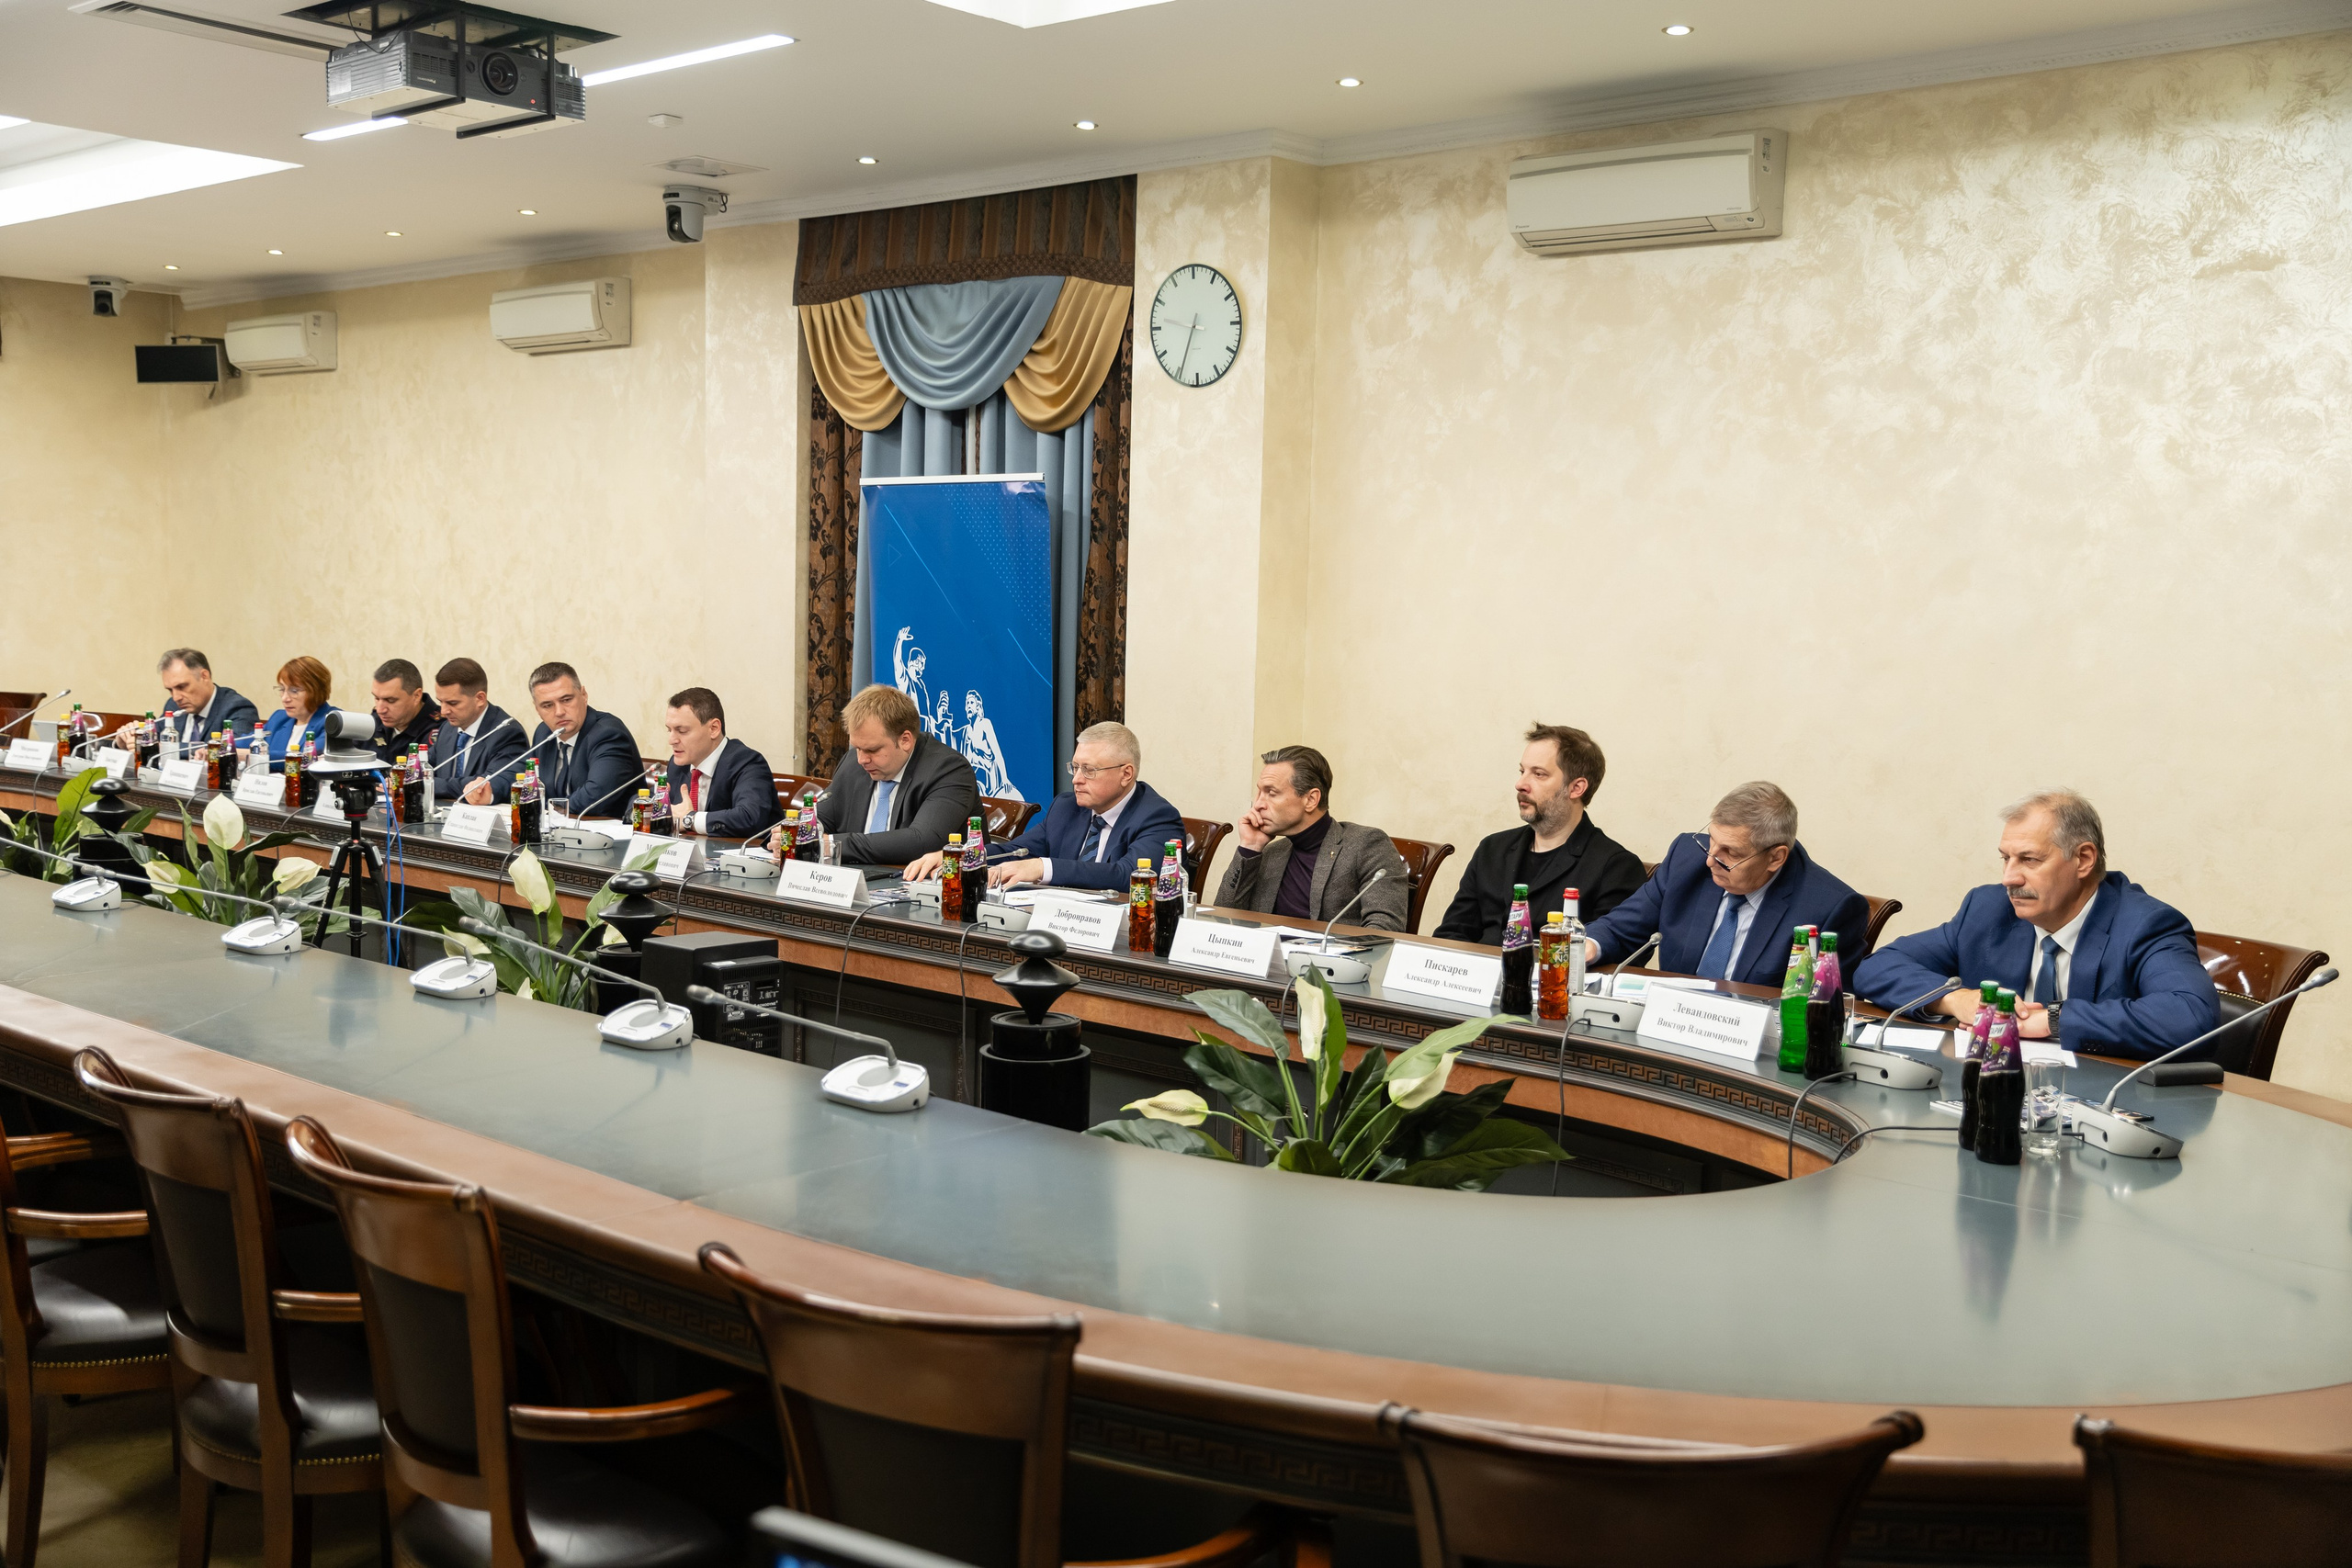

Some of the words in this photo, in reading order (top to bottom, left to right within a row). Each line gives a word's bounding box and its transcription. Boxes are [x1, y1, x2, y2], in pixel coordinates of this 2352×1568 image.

[809, 871, 832, 883] Керов
[787, 882, 810, 892] Вячеслав
[811, 886, 848, 898] Всеволодович
[1054, 908, 1102, 924] Добронравов
[1047, 922, 1068, 932] Виктор
[1069, 926, 1100, 938] Федорович
[1207, 933, 1243, 948] Цыпкин
[1191, 947, 1221, 958] Александр
[1221, 952, 1255, 964] Евгеньевич
[1424, 959, 1468, 976] Пискарев
[1404, 973, 1440, 987] Александр
[1442, 980, 1482, 995] Алексеевич
[1673, 1002, 1741, 1027] Левандовский
[1657, 1017, 1686, 1032] Виктор
[1687, 1024, 1748, 1047] Владимирович
